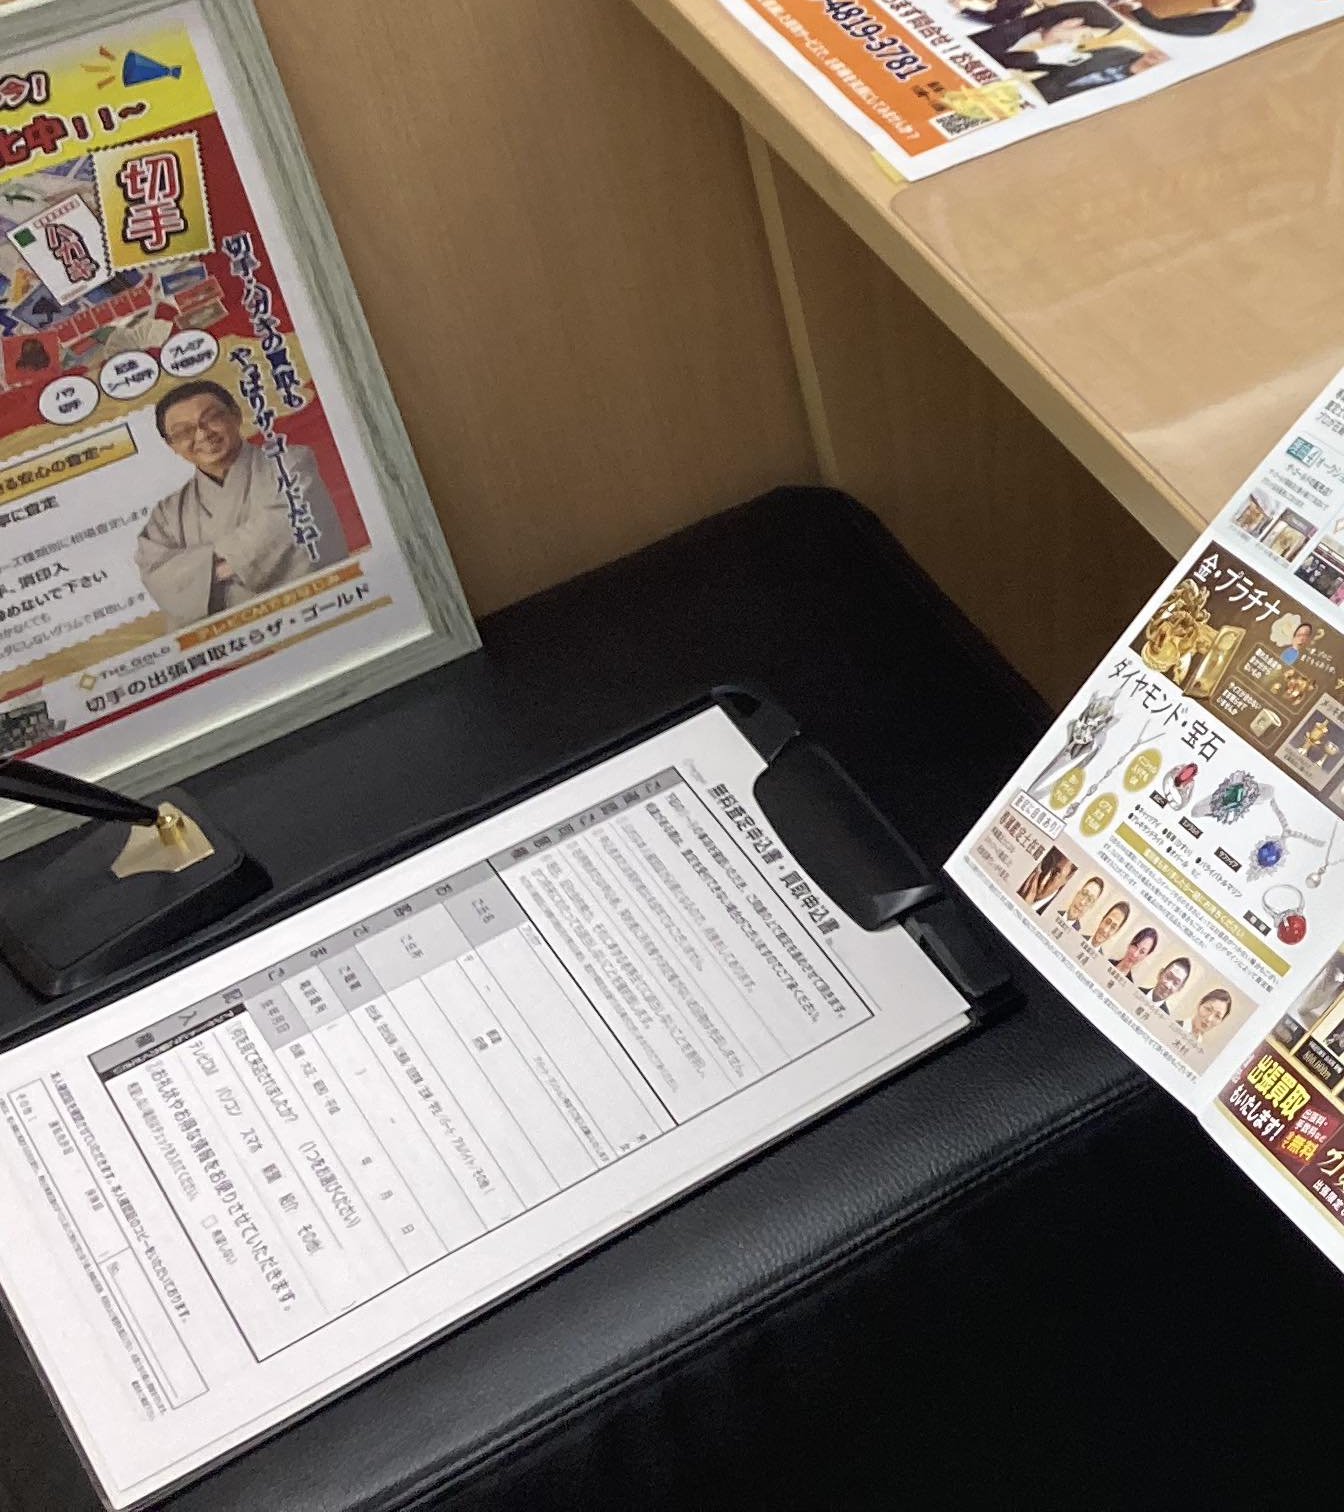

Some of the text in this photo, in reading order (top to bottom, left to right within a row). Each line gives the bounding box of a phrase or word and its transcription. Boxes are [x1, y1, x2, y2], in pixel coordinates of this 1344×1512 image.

[117, 153, 188, 254] 切手
[1191, 547, 1286, 630] 金・プラチナ
[1103, 657, 1228, 763] ダイヤモンド・宝石
[1222, 1087, 1286, 1142] もいたします!
[1240, 1053, 1316, 1121] 出張買取
